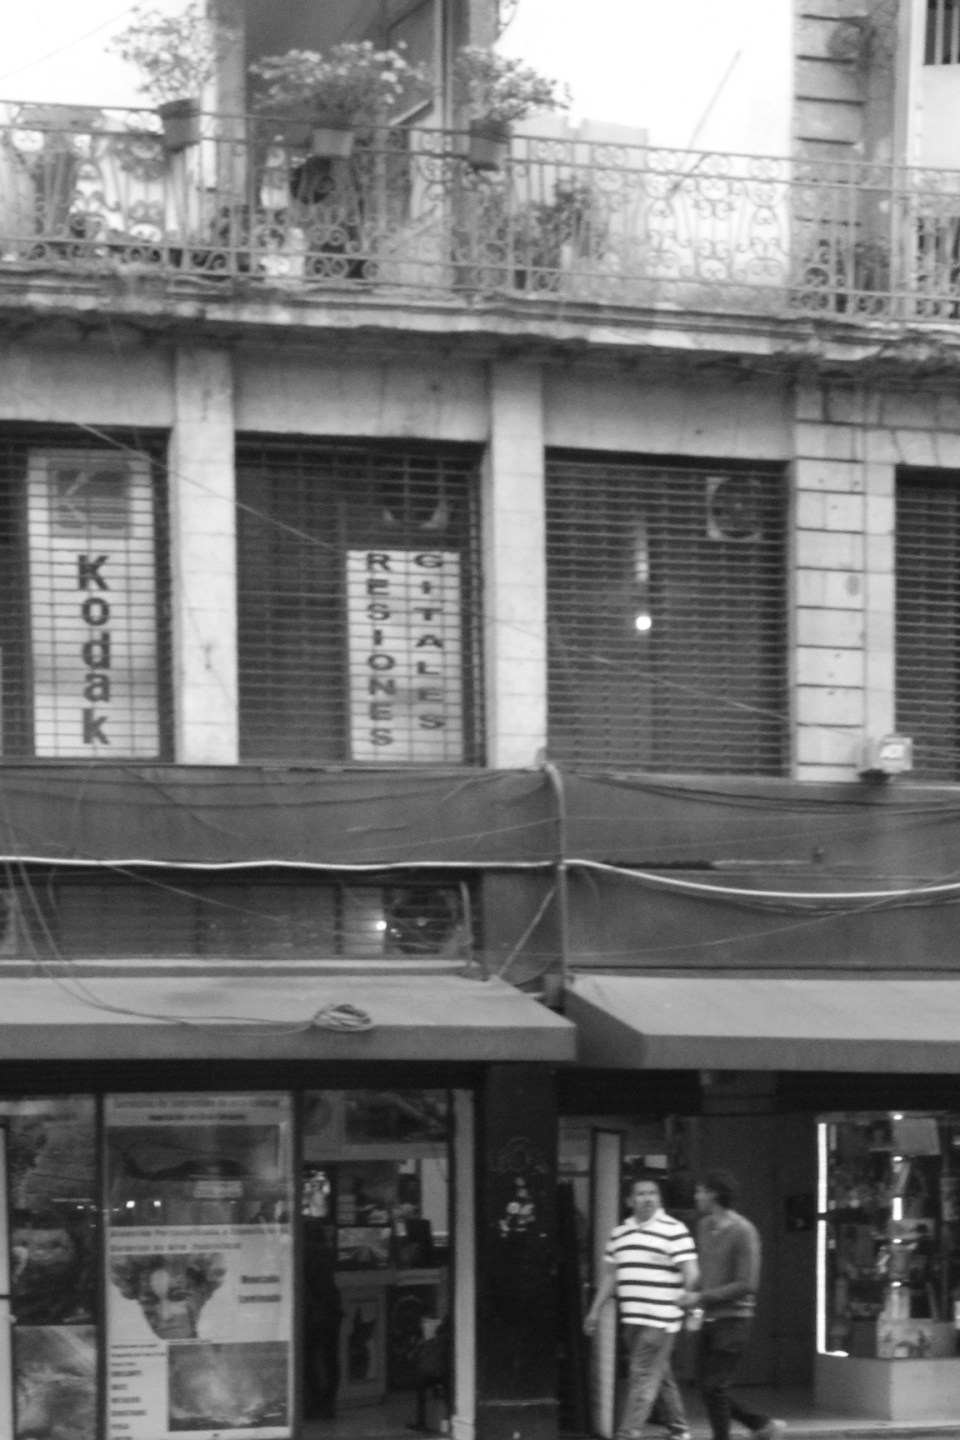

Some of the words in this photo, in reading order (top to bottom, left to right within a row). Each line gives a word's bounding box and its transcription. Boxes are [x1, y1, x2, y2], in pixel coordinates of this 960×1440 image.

[77, 554, 111, 745] Kodak
[366, 553, 395, 746] RESIONES
[414, 554, 446, 730] GITALES
